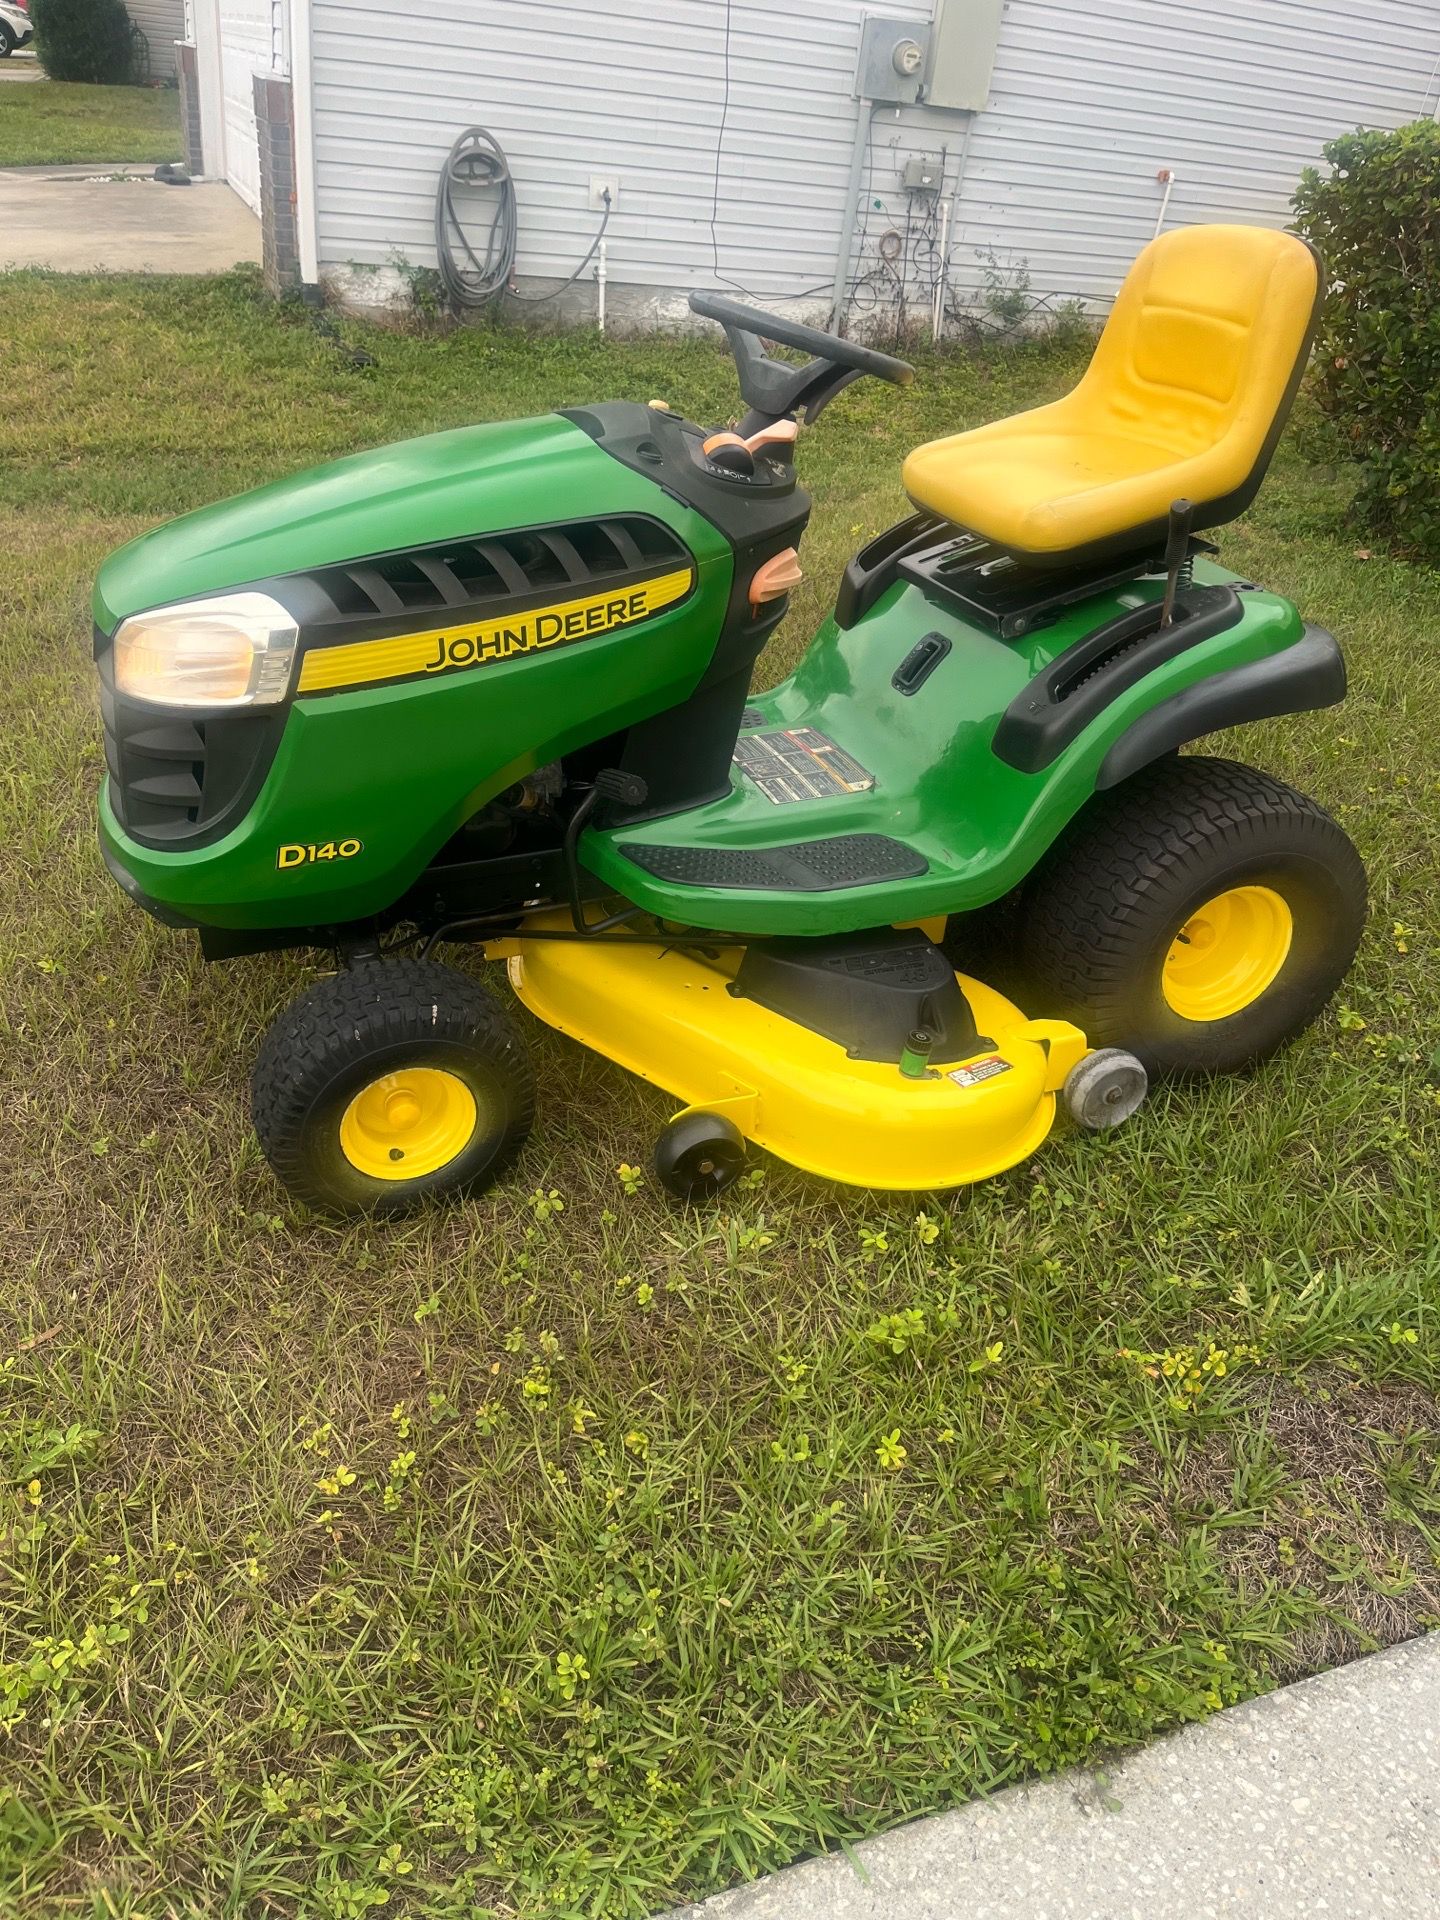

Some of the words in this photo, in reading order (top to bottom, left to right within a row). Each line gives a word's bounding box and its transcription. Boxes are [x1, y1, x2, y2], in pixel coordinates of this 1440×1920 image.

[425, 625, 529, 670] JOHN
[535, 590, 648, 645] DEERE
[278, 839, 361, 869] D140
